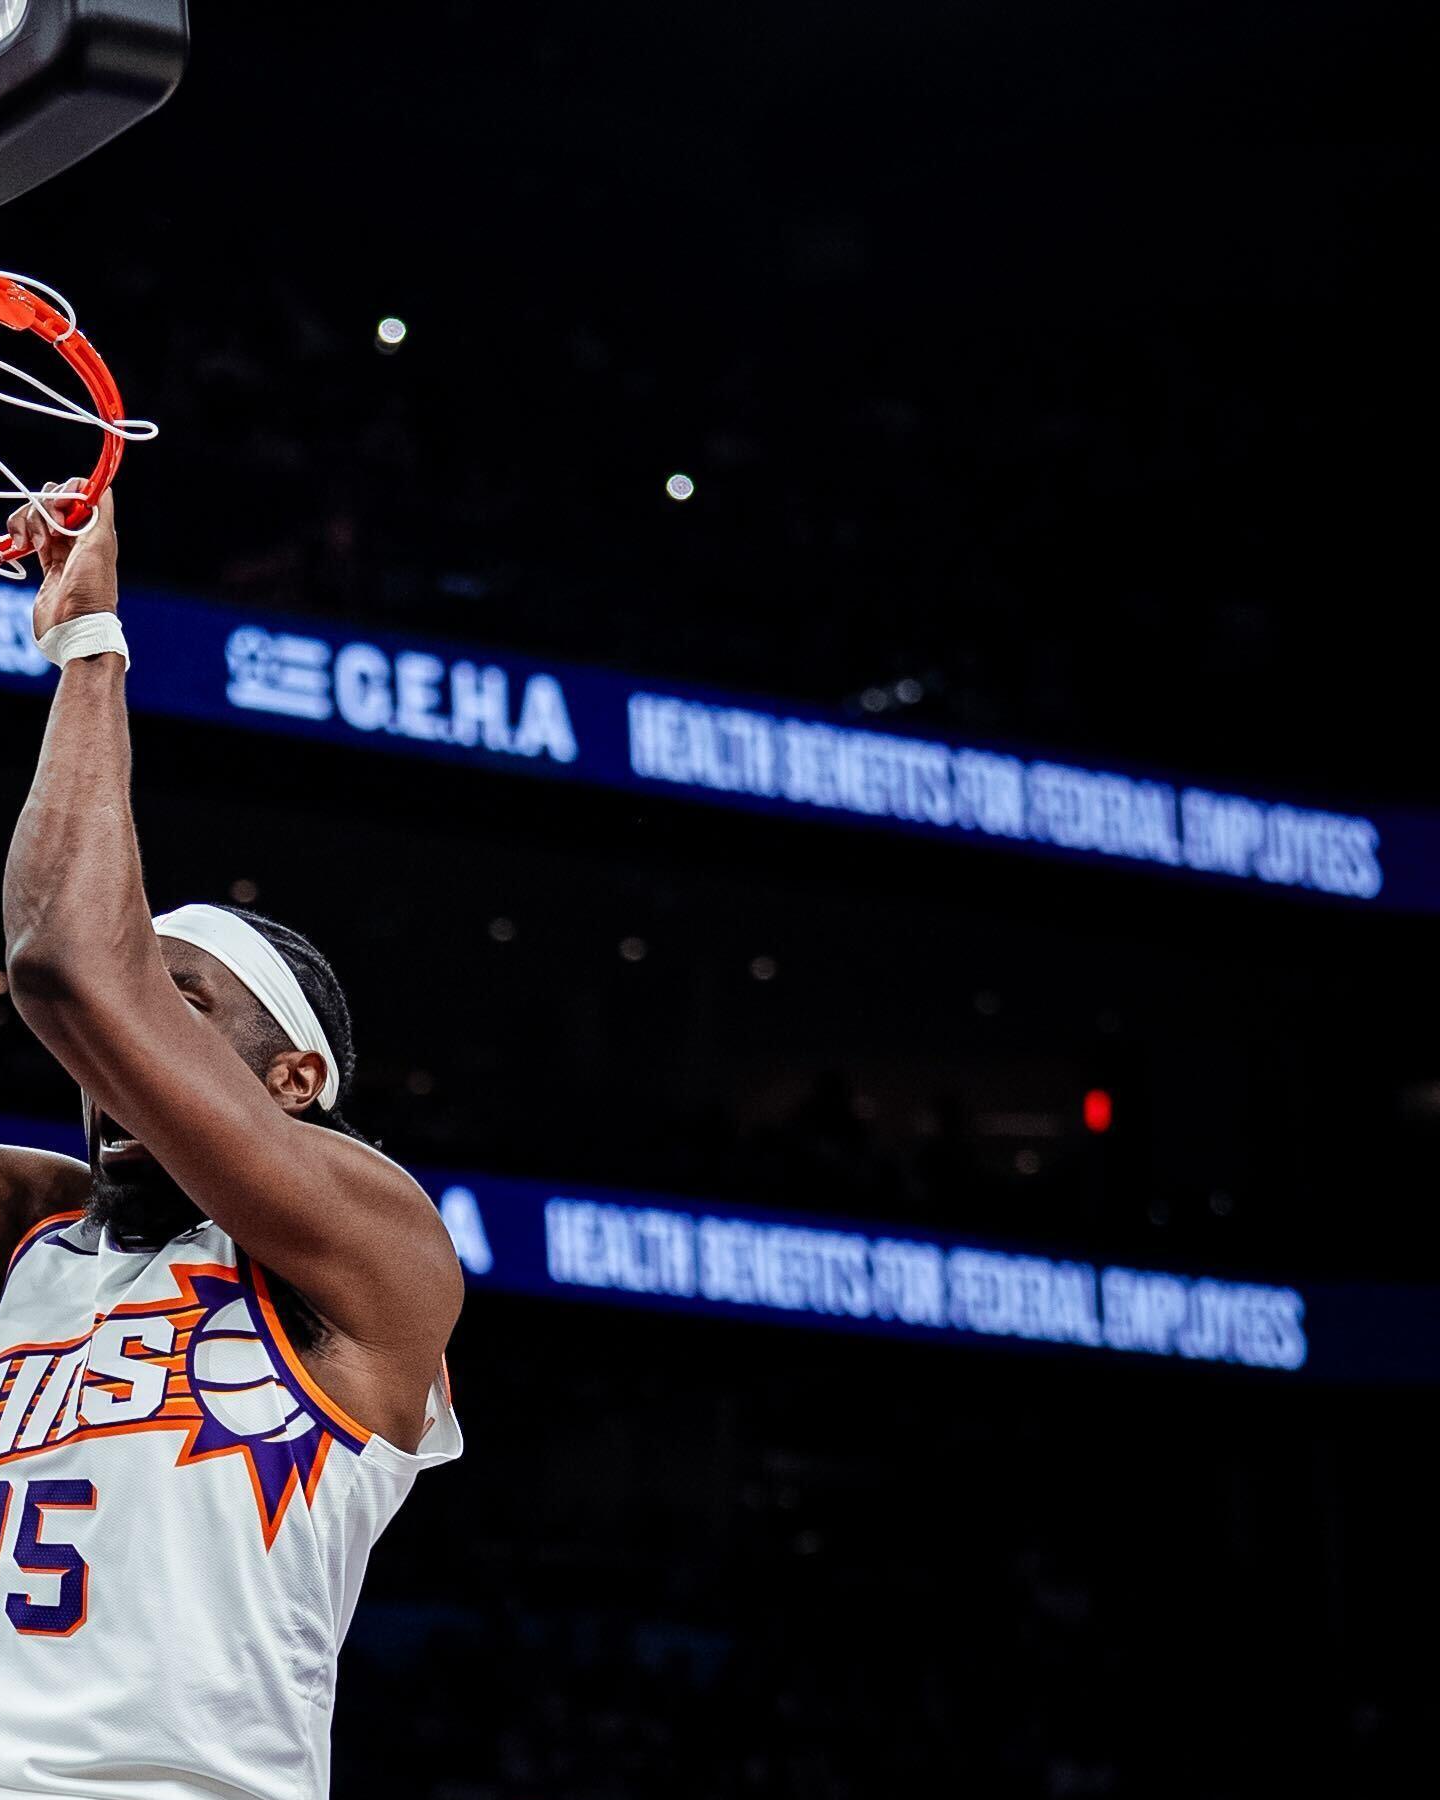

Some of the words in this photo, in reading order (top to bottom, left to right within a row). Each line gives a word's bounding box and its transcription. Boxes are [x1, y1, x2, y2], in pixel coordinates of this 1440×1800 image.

[626, 690, 778, 799] HEALTH
[783, 716, 956, 828] BENEFITS
[957, 746, 1024, 840] FOR
[1026, 759, 1179, 867] FEDERAL
[1181, 786, 1384, 900] EMPLOYEES
[544, 1196, 695, 1298] HEALTH
[697, 1214, 872, 1319] BENEFITS
[872, 1236, 945, 1329] FOR
[947, 1246, 1100, 1347] FEDERAL
[1101, 1265, 1307, 1371] EMPLOYEES
